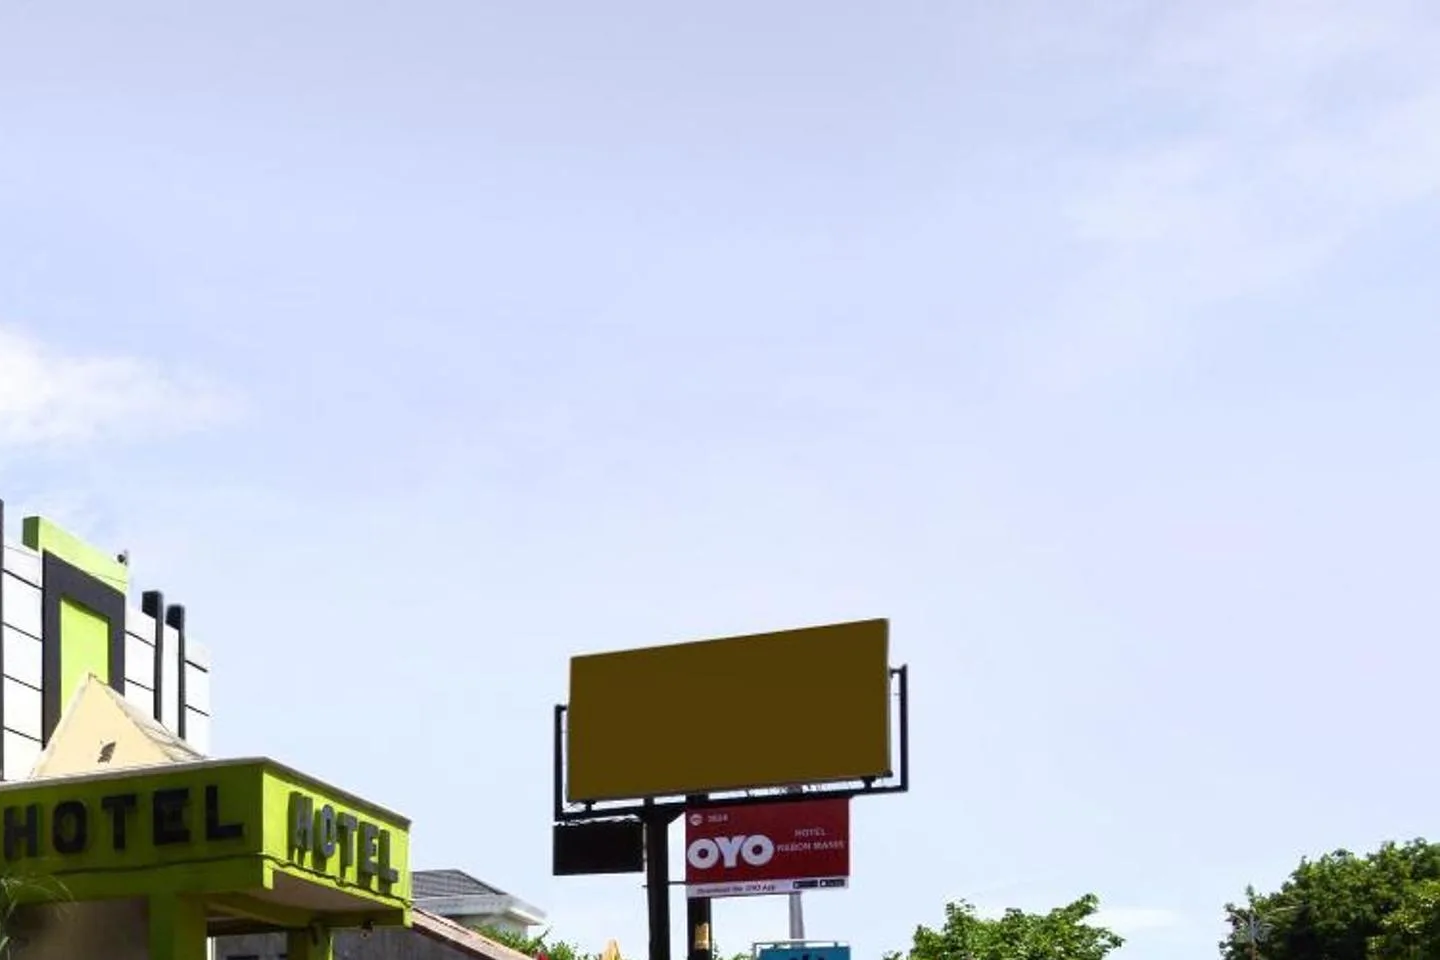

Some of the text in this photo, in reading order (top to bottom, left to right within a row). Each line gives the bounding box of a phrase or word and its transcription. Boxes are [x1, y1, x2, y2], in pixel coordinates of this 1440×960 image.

[3, 784, 245, 863] HOTEL
[287, 789, 400, 893] HOTEL
[687, 834, 775, 870] OYO
